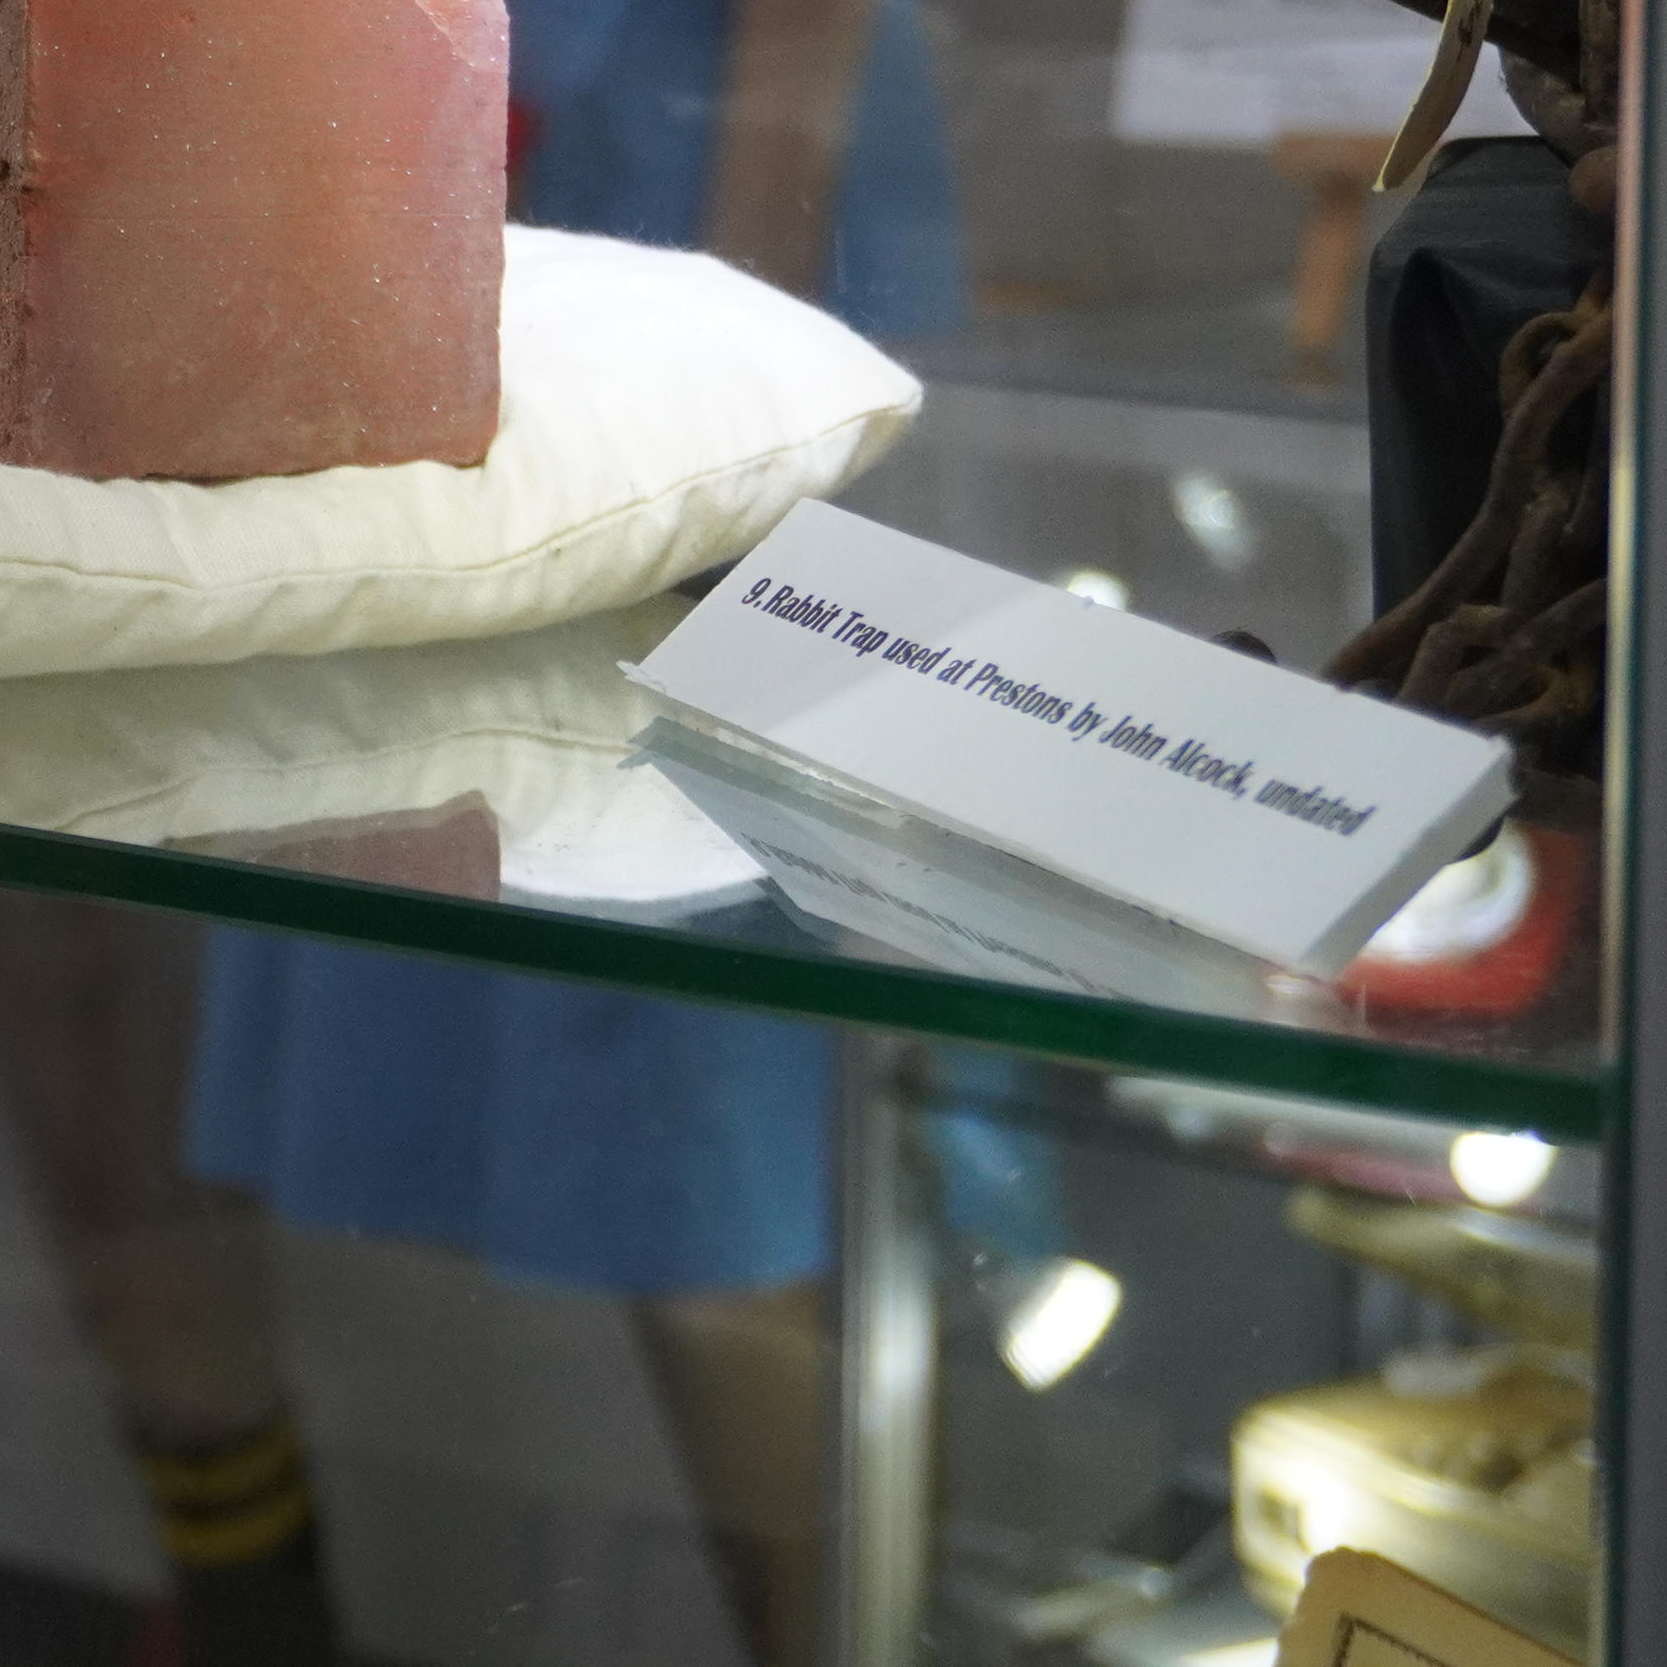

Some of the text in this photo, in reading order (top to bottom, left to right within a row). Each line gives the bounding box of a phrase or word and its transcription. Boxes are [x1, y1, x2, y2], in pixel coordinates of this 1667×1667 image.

[830, 610, 891, 659] Trap
[881, 636, 953, 676] used
[935, 657, 979, 686] at
[962, 661, 1074, 726] Prestons
[1065, 701, 1109, 744] by
[1097, 714, 1169, 762] John
[1157, 737, 1257, 801] Alcock,
[1252, 778, 1380, 838] undated
